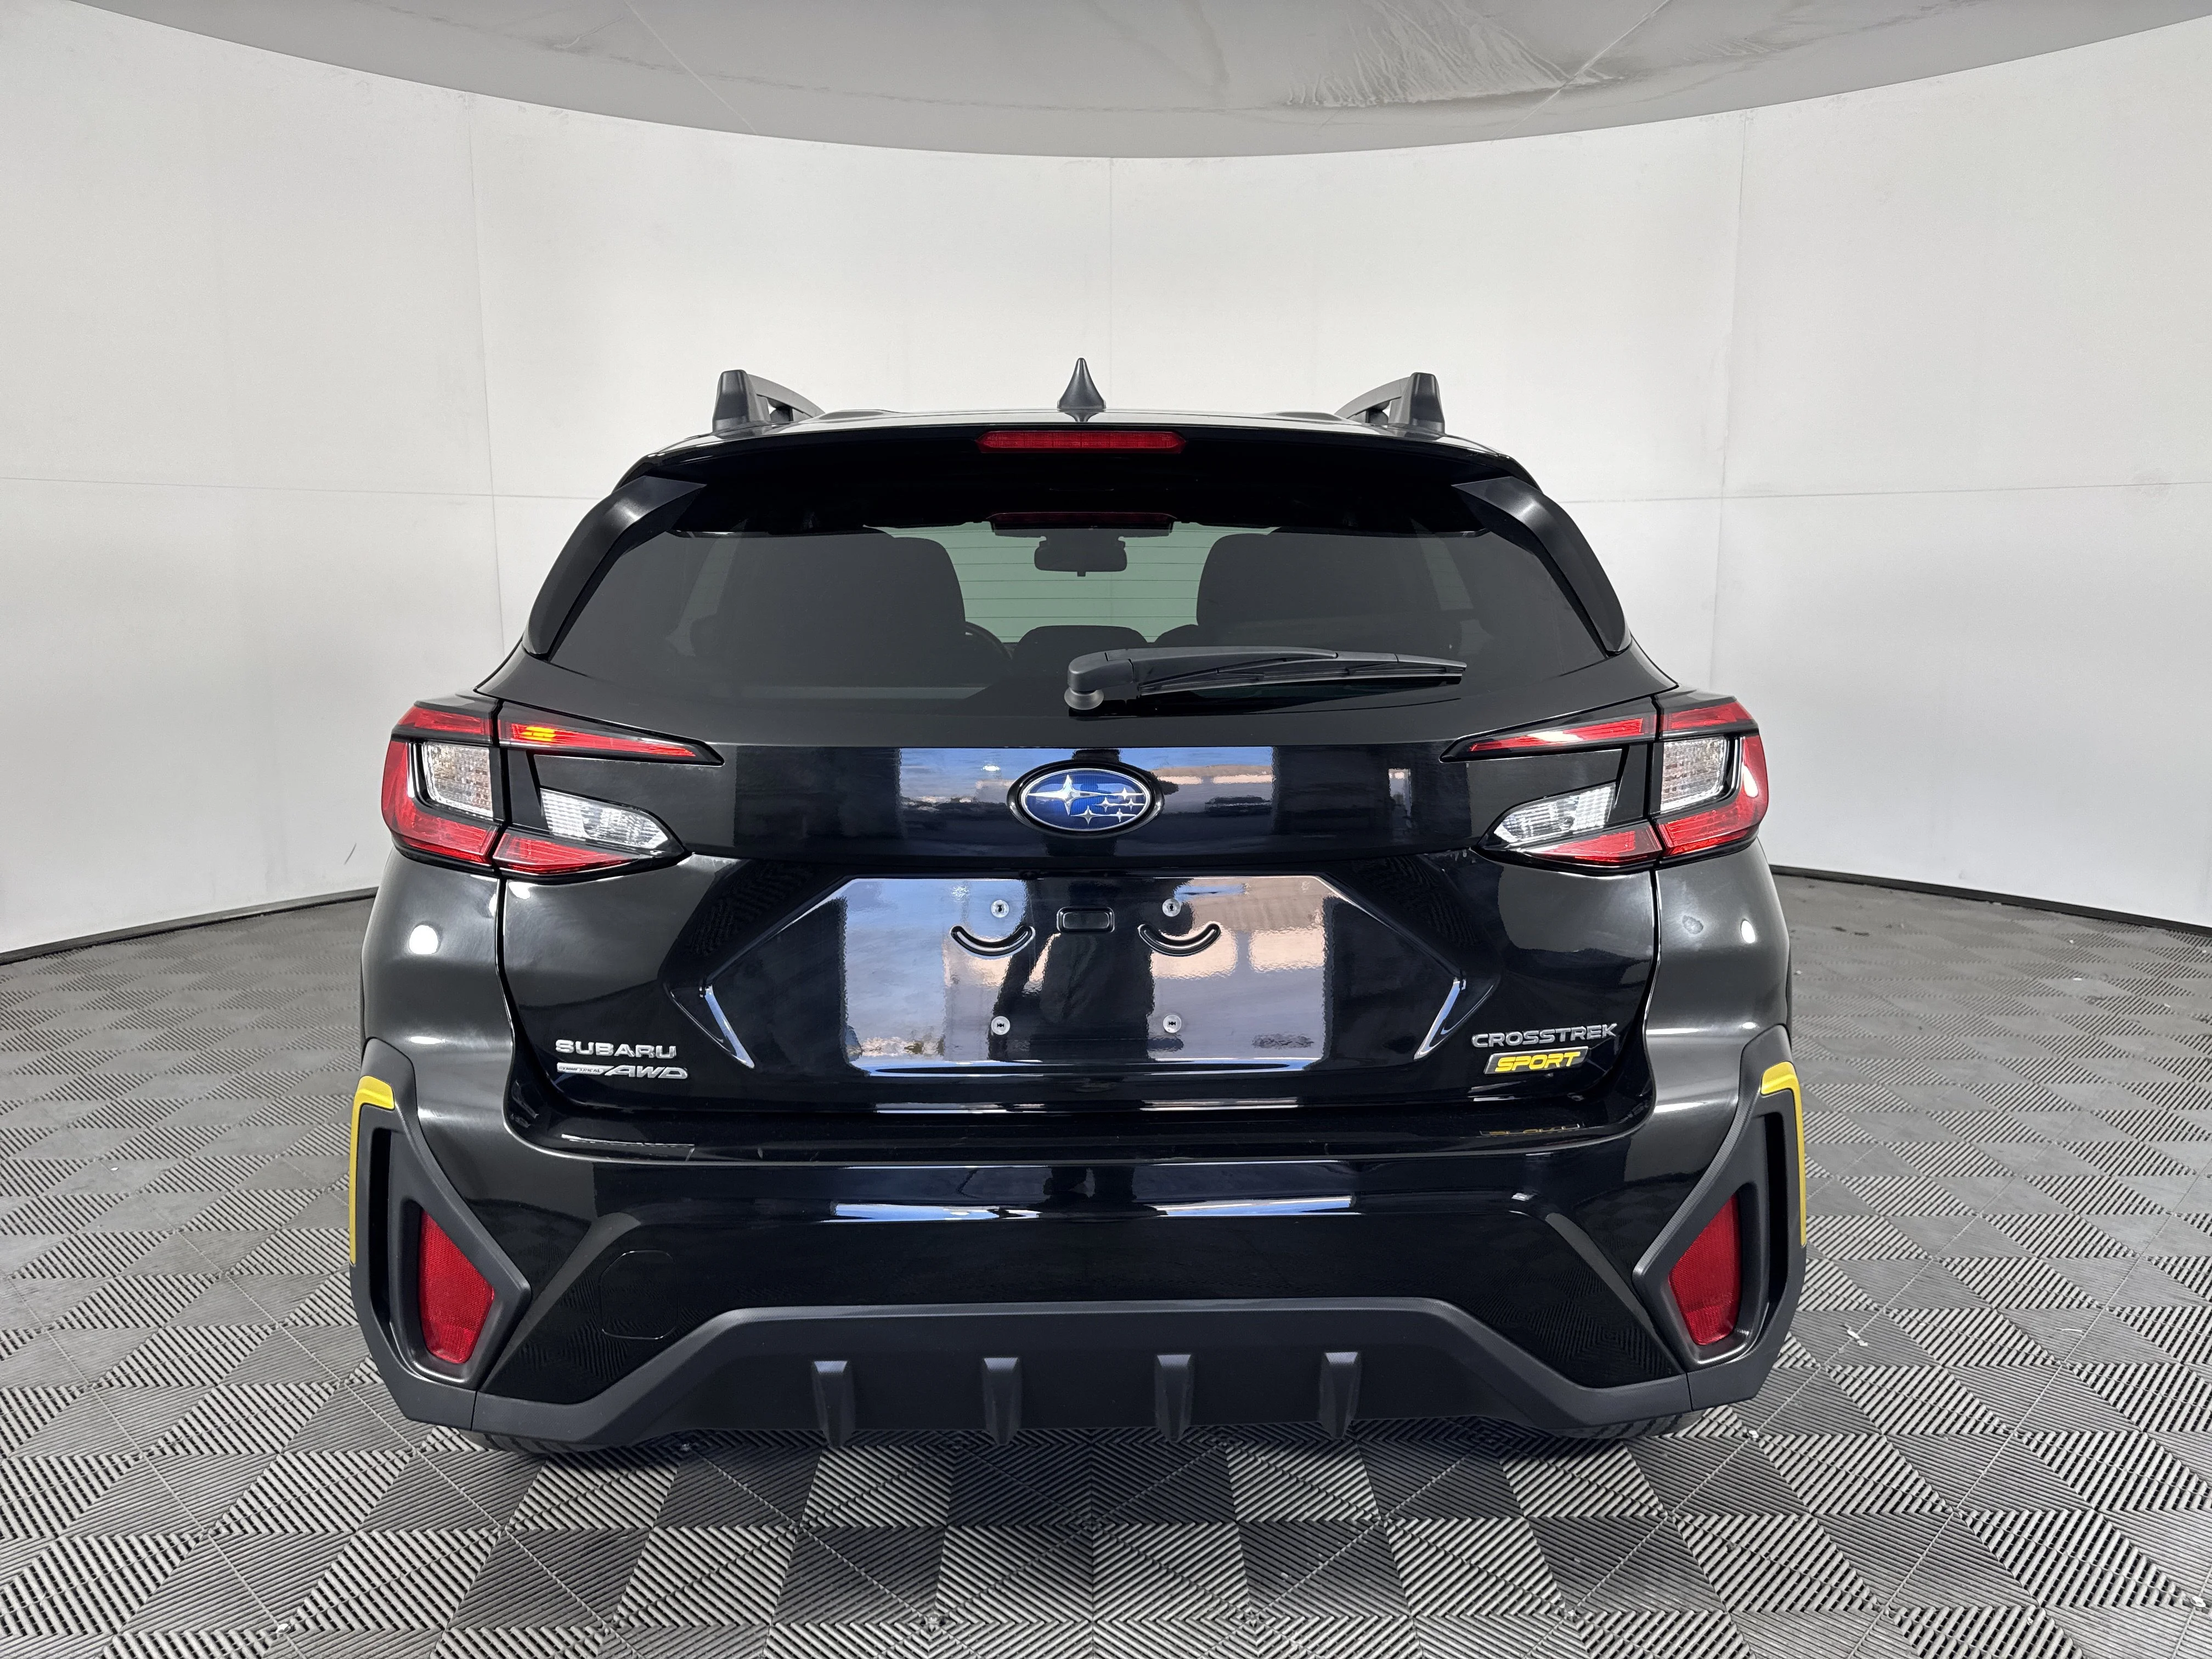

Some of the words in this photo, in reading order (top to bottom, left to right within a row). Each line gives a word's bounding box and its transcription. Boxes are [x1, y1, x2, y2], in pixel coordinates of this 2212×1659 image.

[1472, 1023, 1617, 1048] CROSSTREK
[555, 1039, 677, 1059] SUBARU
[1494, 1051, 1581, 1072] SPORT
[605, 1065, 688, 1079] AWD
